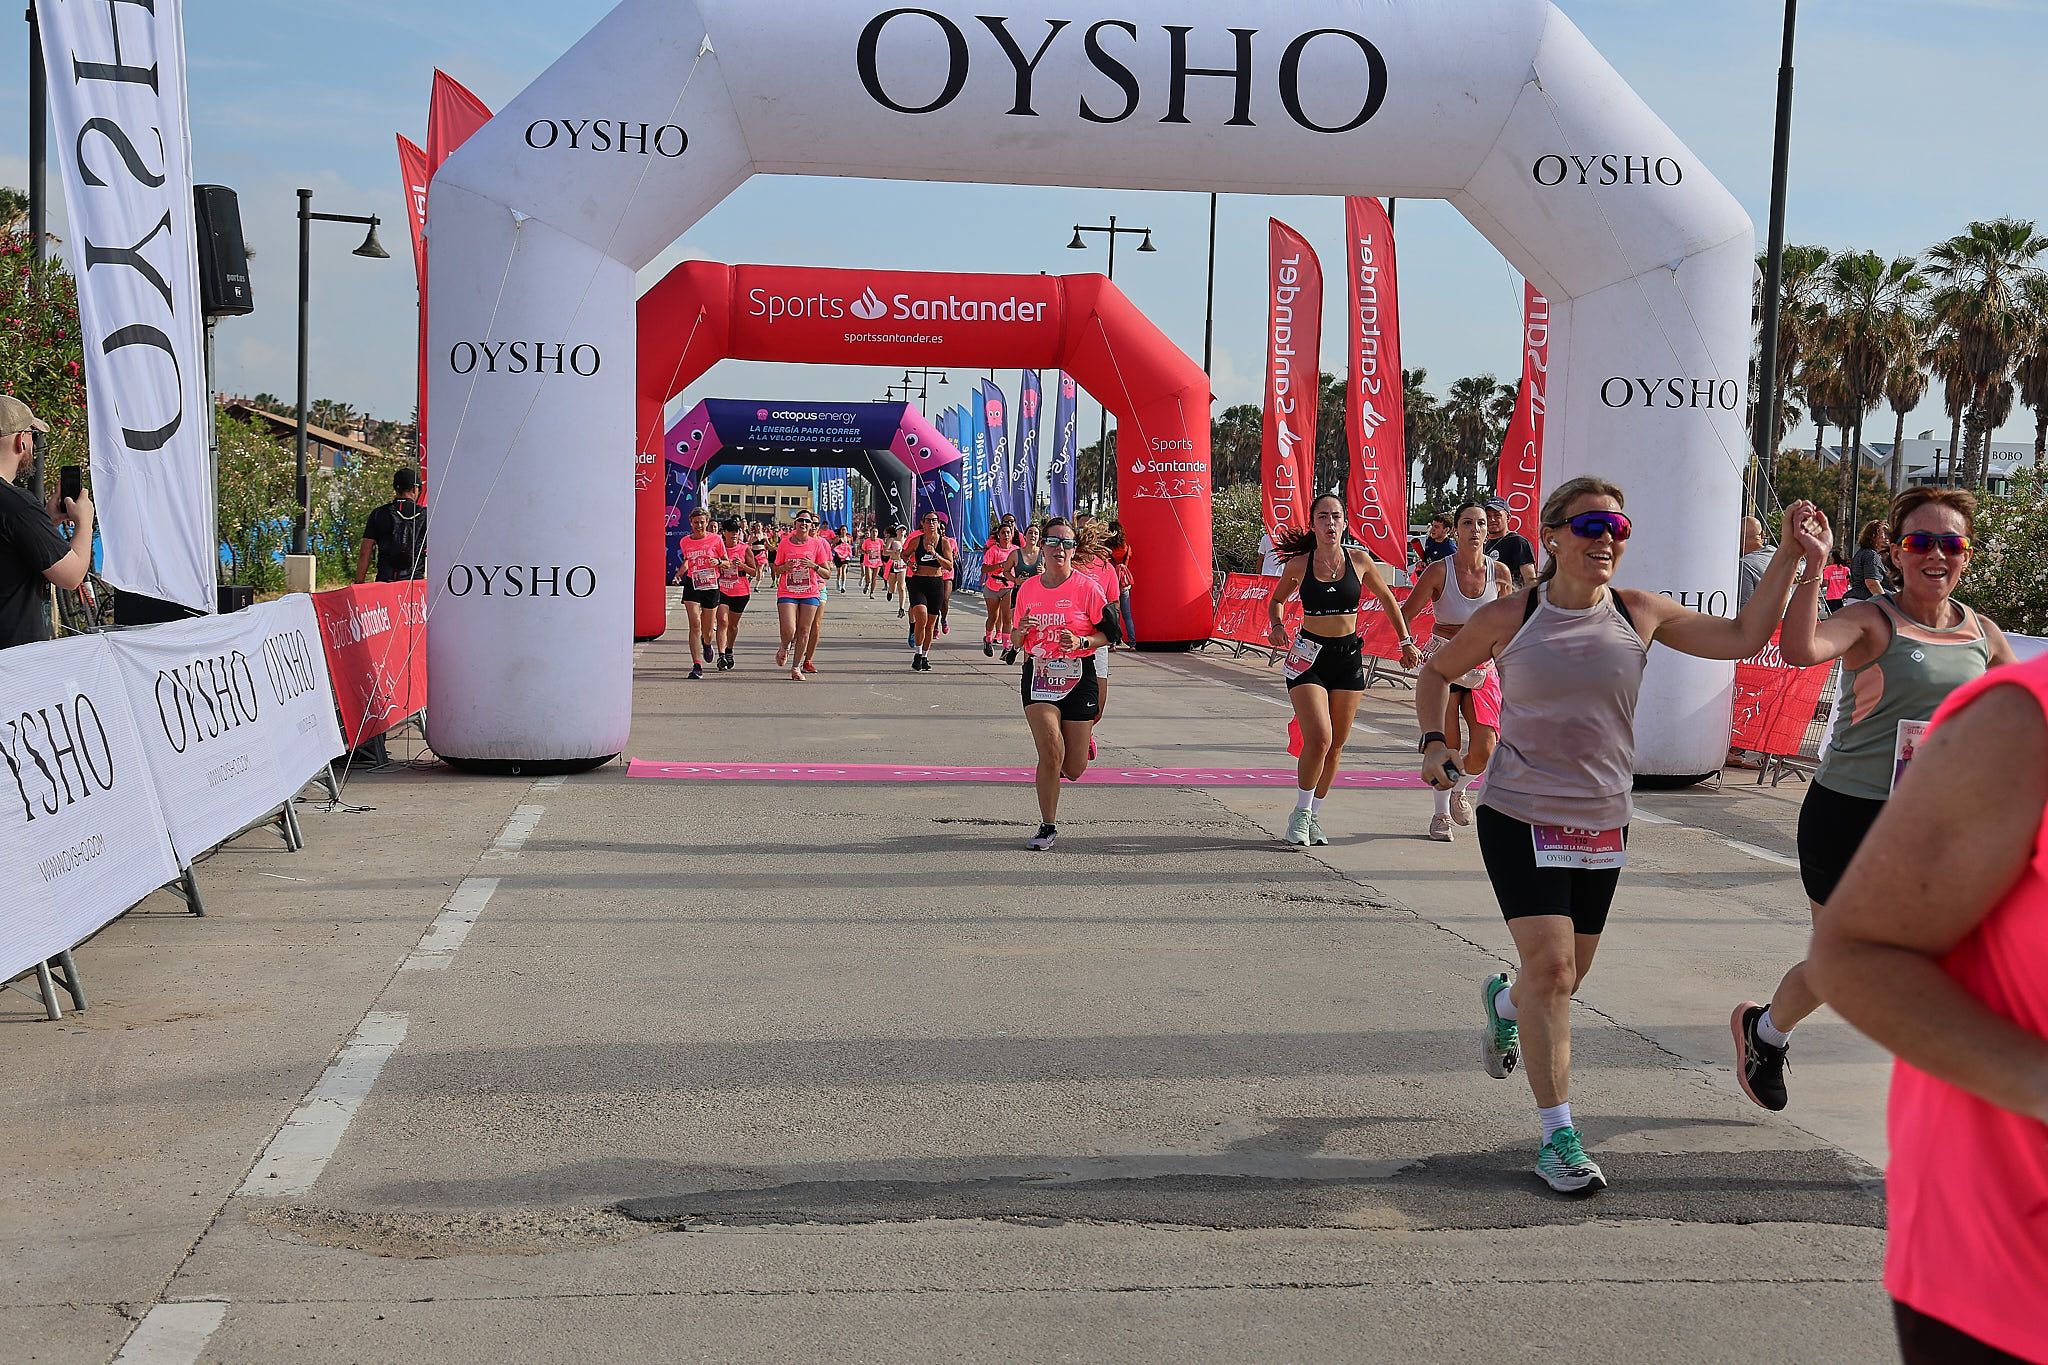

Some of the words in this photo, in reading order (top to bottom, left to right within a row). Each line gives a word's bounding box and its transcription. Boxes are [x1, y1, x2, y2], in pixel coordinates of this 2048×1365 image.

[856, 7, 1388, 133] OYSHO
[525, 118, 689, 158] OYSHO
[1532, 154, 1683, 186] OYSHO
[750, 288, 844, 324] Sports
[893, 294, 1047, 322] Santander
[844, 332, 943, 344] sportssantander.es
[449, 341, 601, 377] OYSHO
[1601, 376, 1738, 410] OYSHO
[749, 425, 761, 433] LA
[762, 424, 799, 434] ENERGÍA
[772, 410, 818, 422] octopus
[818, 412, 857, 424] energy
[770, 434, 818, 442] VELOCIDAD
[1151, 437, 1193, 453] Sports
[1147, 460, 1207, 472] Santander
[1992, 451, 2023, 461] BOBO
[742, 465, 790, 482] Marlene
[447, 564, 597, 599] OYSHO
[356, 601, 392, 640] Santander
[1036, 613, 1066, 627] RRERA
[263, 629, 316, 706] OYSHO
[1047, 676, 1066, 686] 016
[155, 650, 258, 753] OYSHO
[0, 693, 114, 822] YSHO
[37, 833, 107, 883] WWW.OYSHO.COM
[1546, 854, 1572, 863] OYSHO
